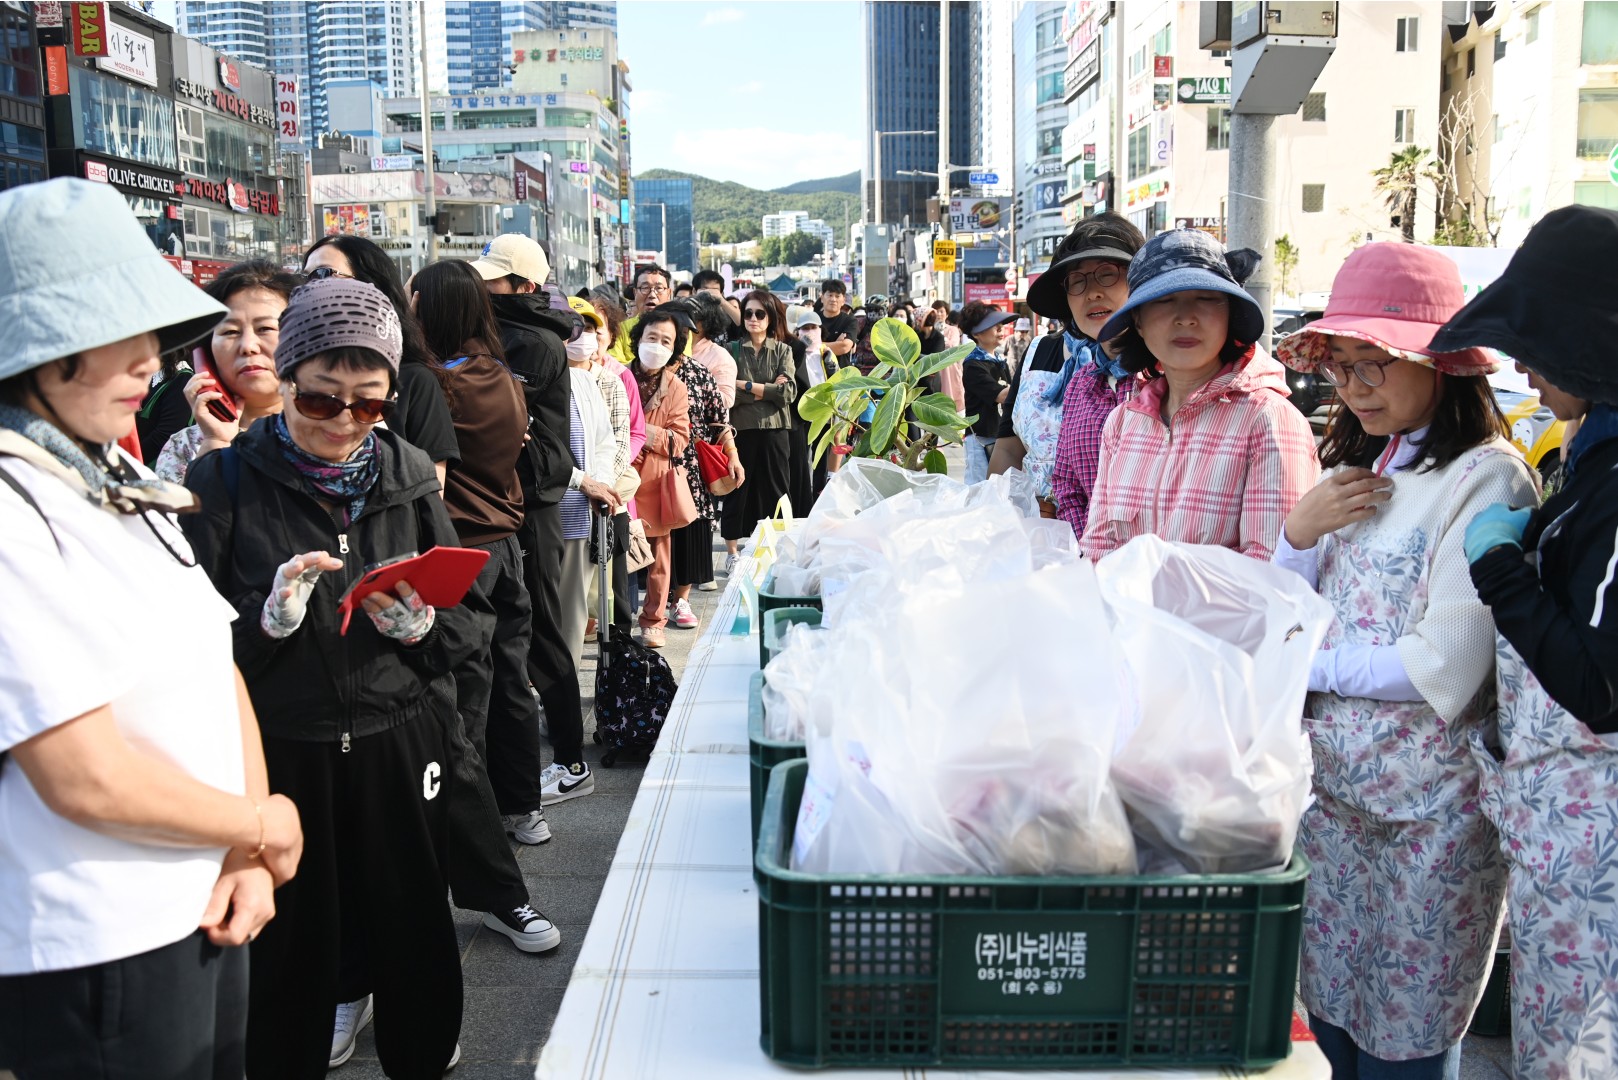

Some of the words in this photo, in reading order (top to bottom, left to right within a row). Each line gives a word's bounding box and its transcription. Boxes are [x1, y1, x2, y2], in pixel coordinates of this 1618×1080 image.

[79, 3, 101, 54] BAR
[114, 61, 135, 73] MODERN
[135, 68, 145, 77] BAR
[179, 77, 212, 106] 국제시장
[213, 89, 249, 120] 개미집
[1194, 77, 1220, 94] TACO
[278, 81, 297, 137] 개미집
[1157, 140, 1168, 160] CU
[108, 167, 137, 187] OLIVE
[137, 173, 175, 194] CHICKEN
[188, 178, 227, 204] 개미집
[249, 189, 279, 217] 낙곱새
[952, 213, 980, 230] 밀면
[1193, 217, 1204, 227] HI
[423, 761, 441, 801] C
[975, 931, 1087, 966] (주)나누리식품
